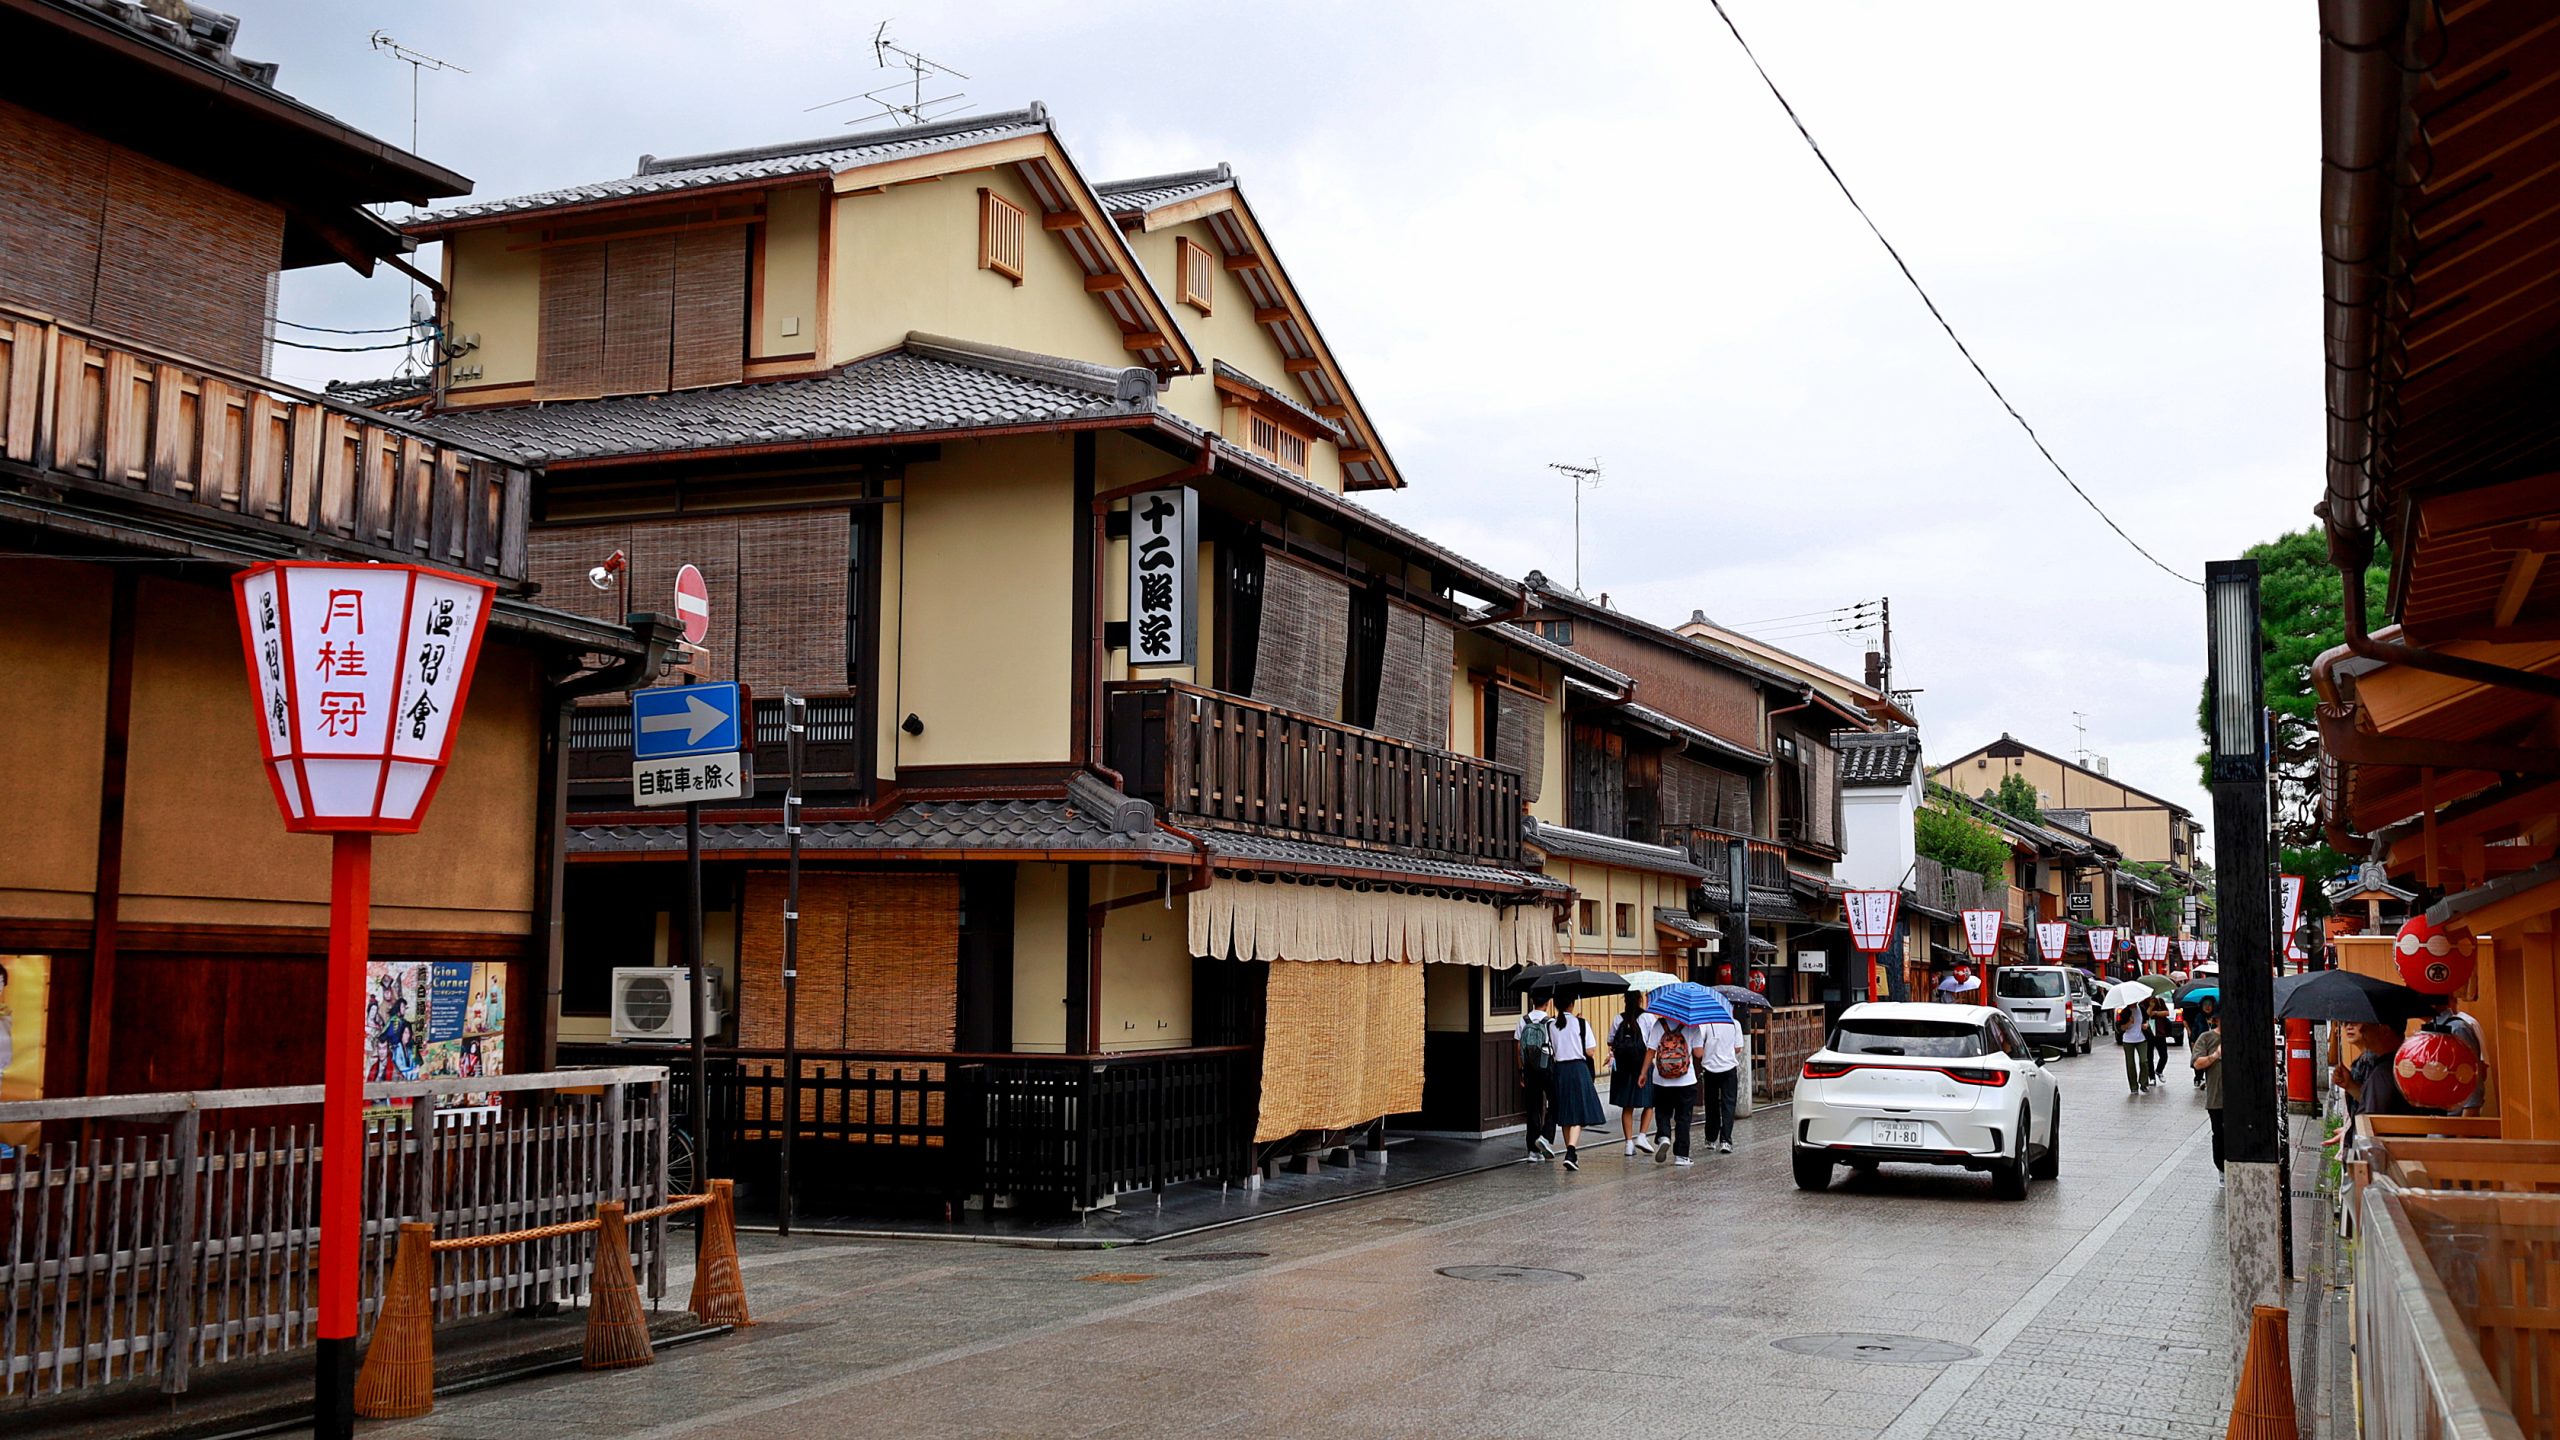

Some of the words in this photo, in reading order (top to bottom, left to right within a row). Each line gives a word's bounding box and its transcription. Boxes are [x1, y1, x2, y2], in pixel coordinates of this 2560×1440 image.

[316, 588, 368, 737] 月桂冠
[638, 764, 735, 796] 自転車を除く
[433, 966, 457, 976] Gion
[432, 977, 469, 988] Corner
[1884, 1130, 1917, 1143] 71-80
